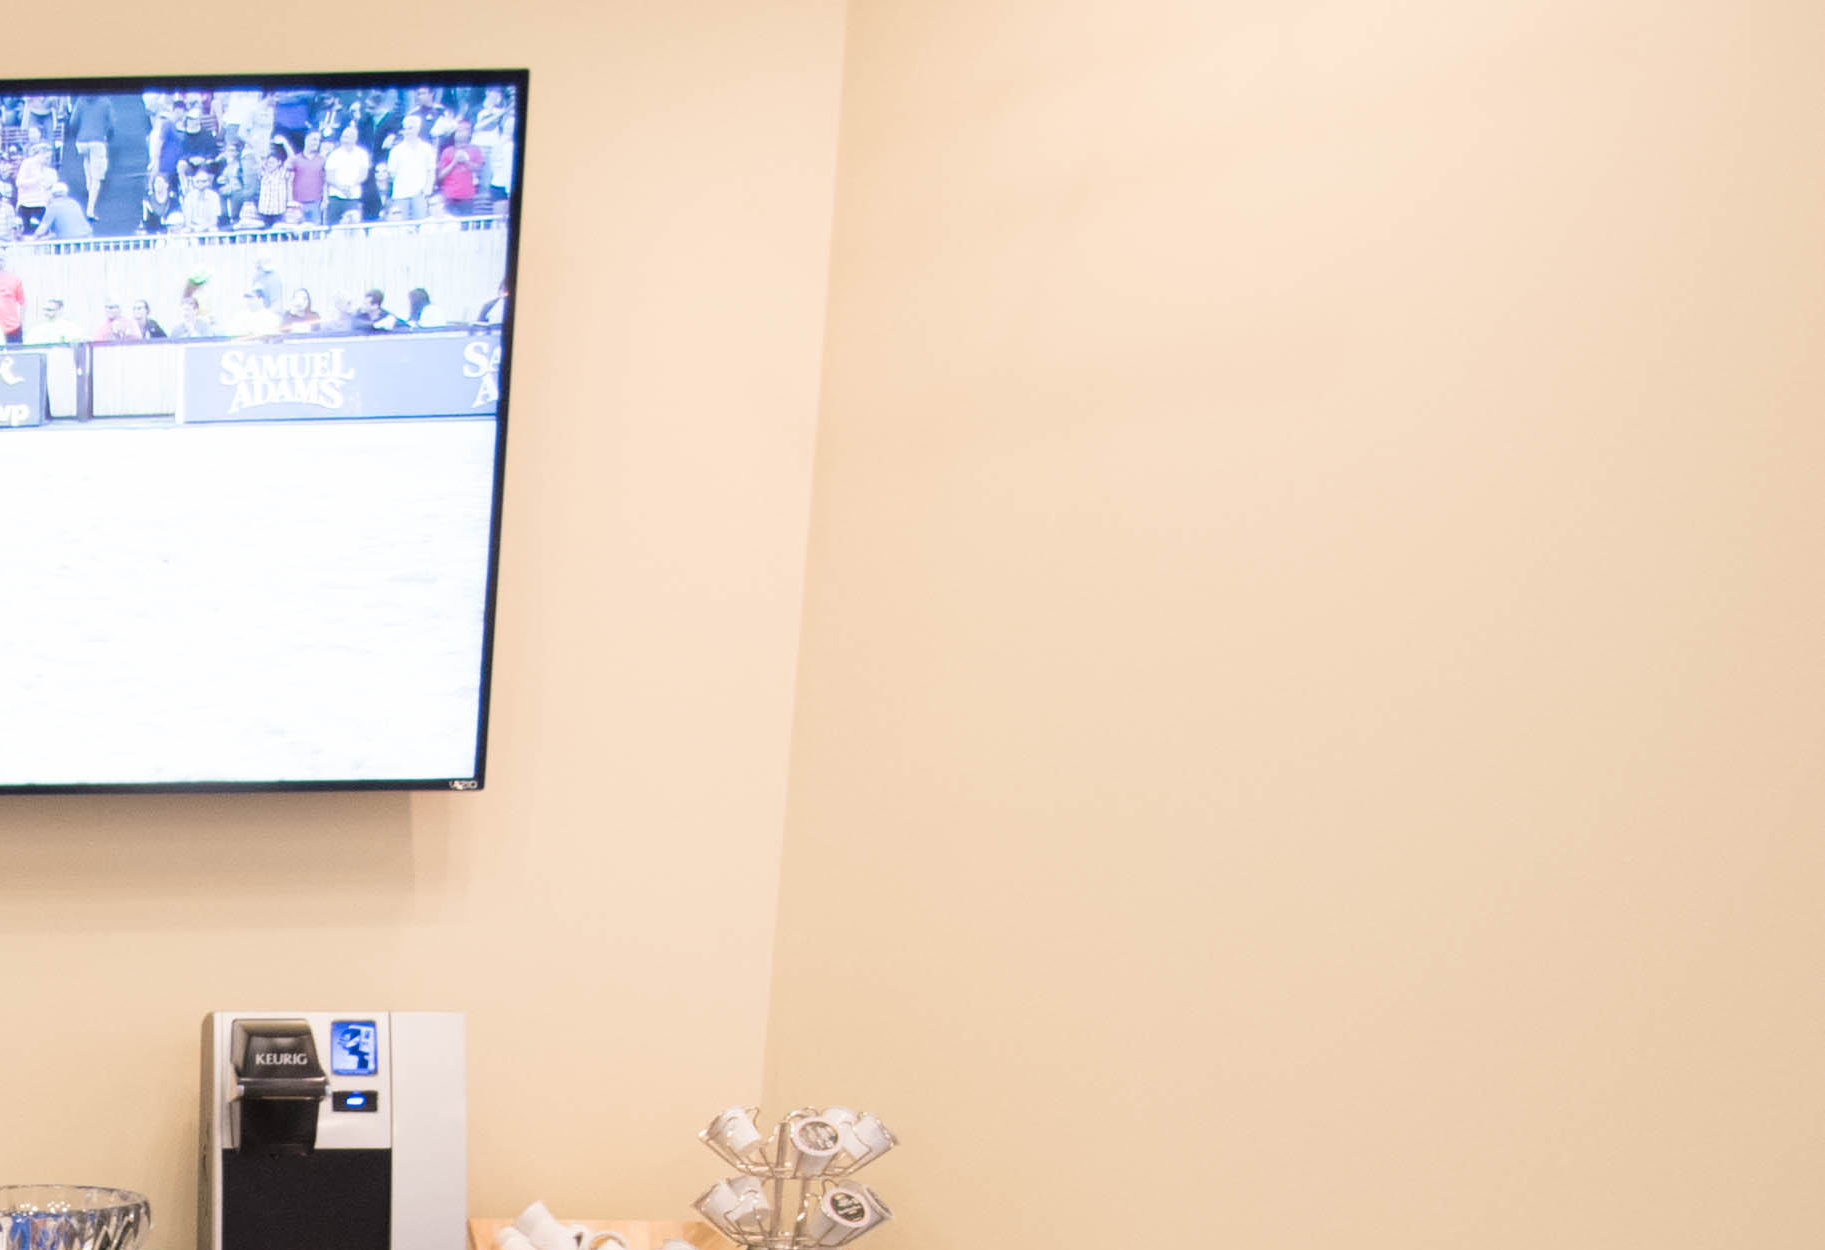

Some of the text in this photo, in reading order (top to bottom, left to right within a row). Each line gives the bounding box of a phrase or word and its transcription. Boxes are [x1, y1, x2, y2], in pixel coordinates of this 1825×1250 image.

[219, 348, 356, 385] SAMUEL
[228, 377, 347, 415] ADAMS
[255, 1053, 308, 1065] KEURIG
